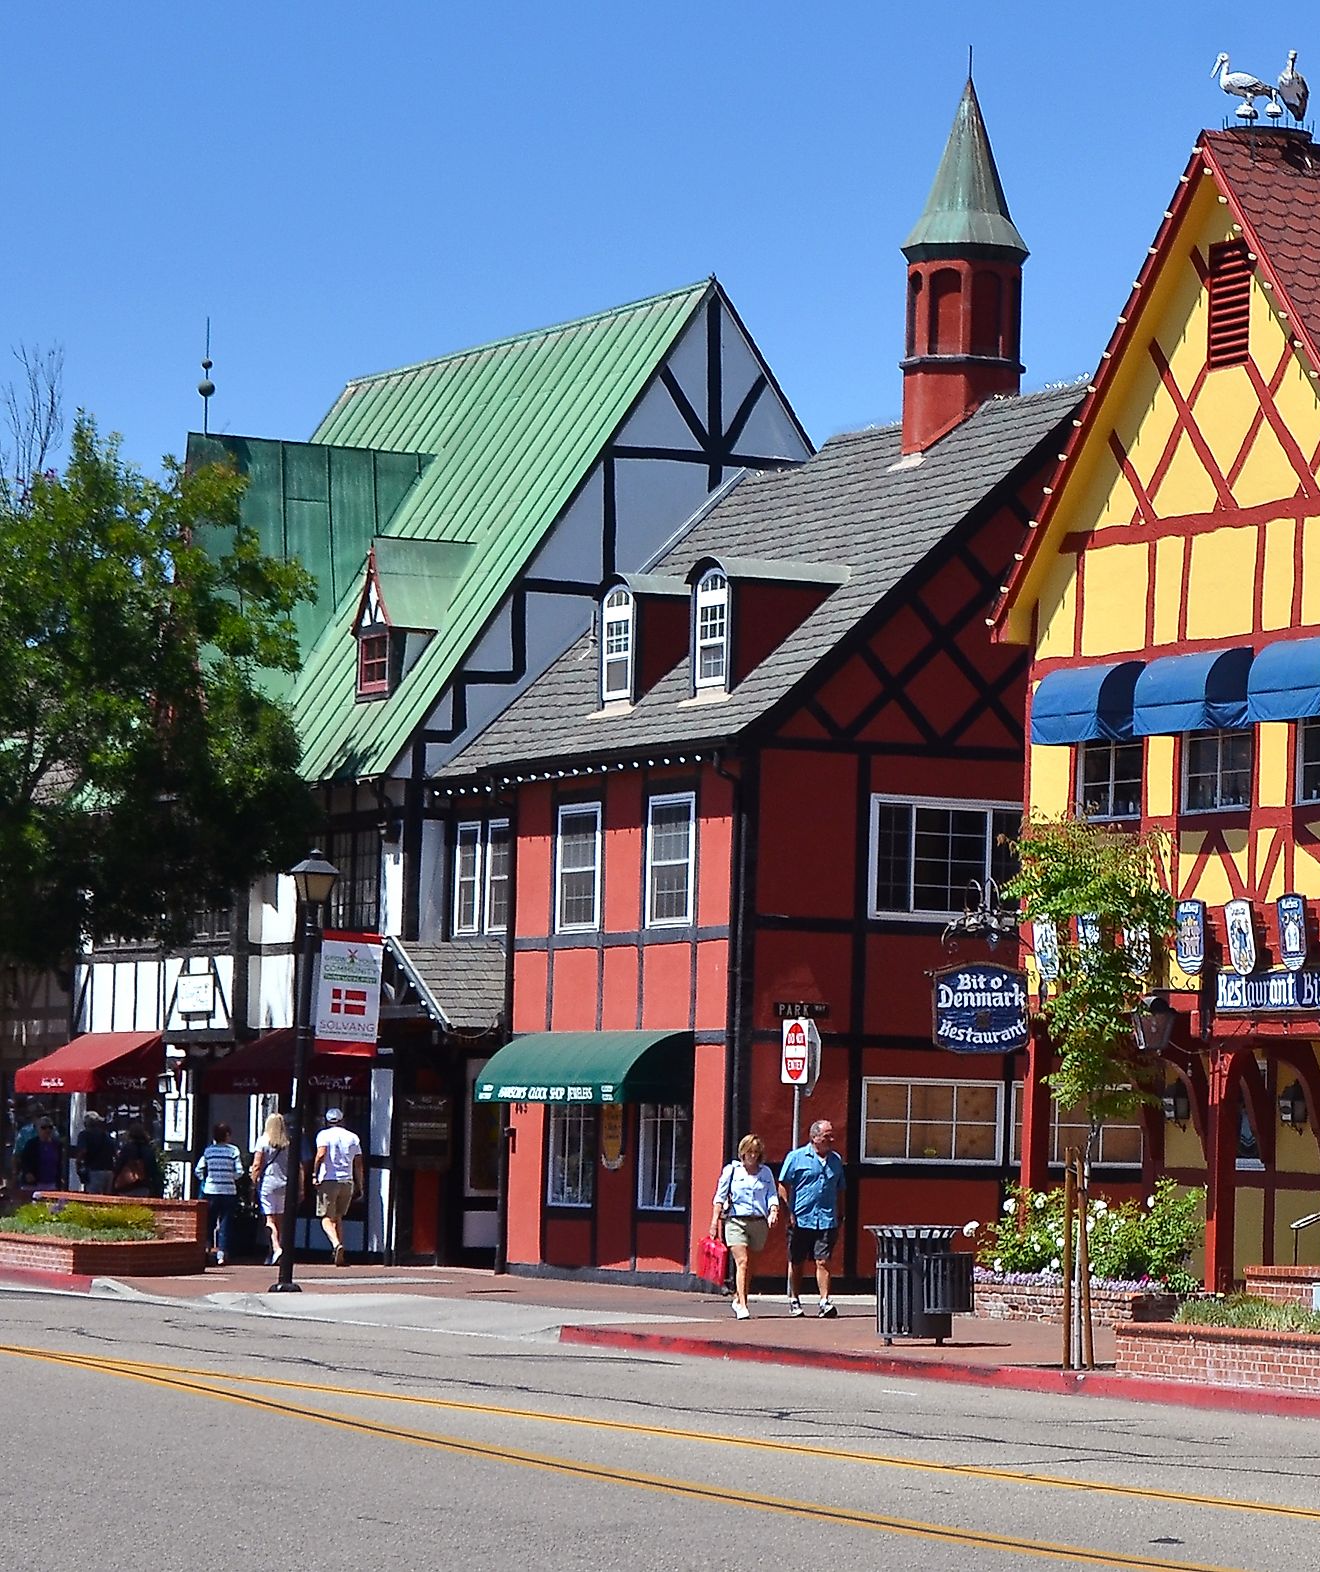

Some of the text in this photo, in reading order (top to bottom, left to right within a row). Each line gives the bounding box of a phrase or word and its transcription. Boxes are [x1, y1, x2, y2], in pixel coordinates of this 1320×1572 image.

[323, 964, 380, 977] COMMUNITY
[956, 973, 1008, 990] Bit o'
[1216, 972, 1295, 1007] Restaurant
[937, 982, 1027, 1008] Denmark
[778, 1004, 810, 1016] PARK
[319, 1019, 375, 1034] SOLVANG
[937, 1018, 1028, 1044] Restaurant
[548, 1087, 566, 1100] SHOP
